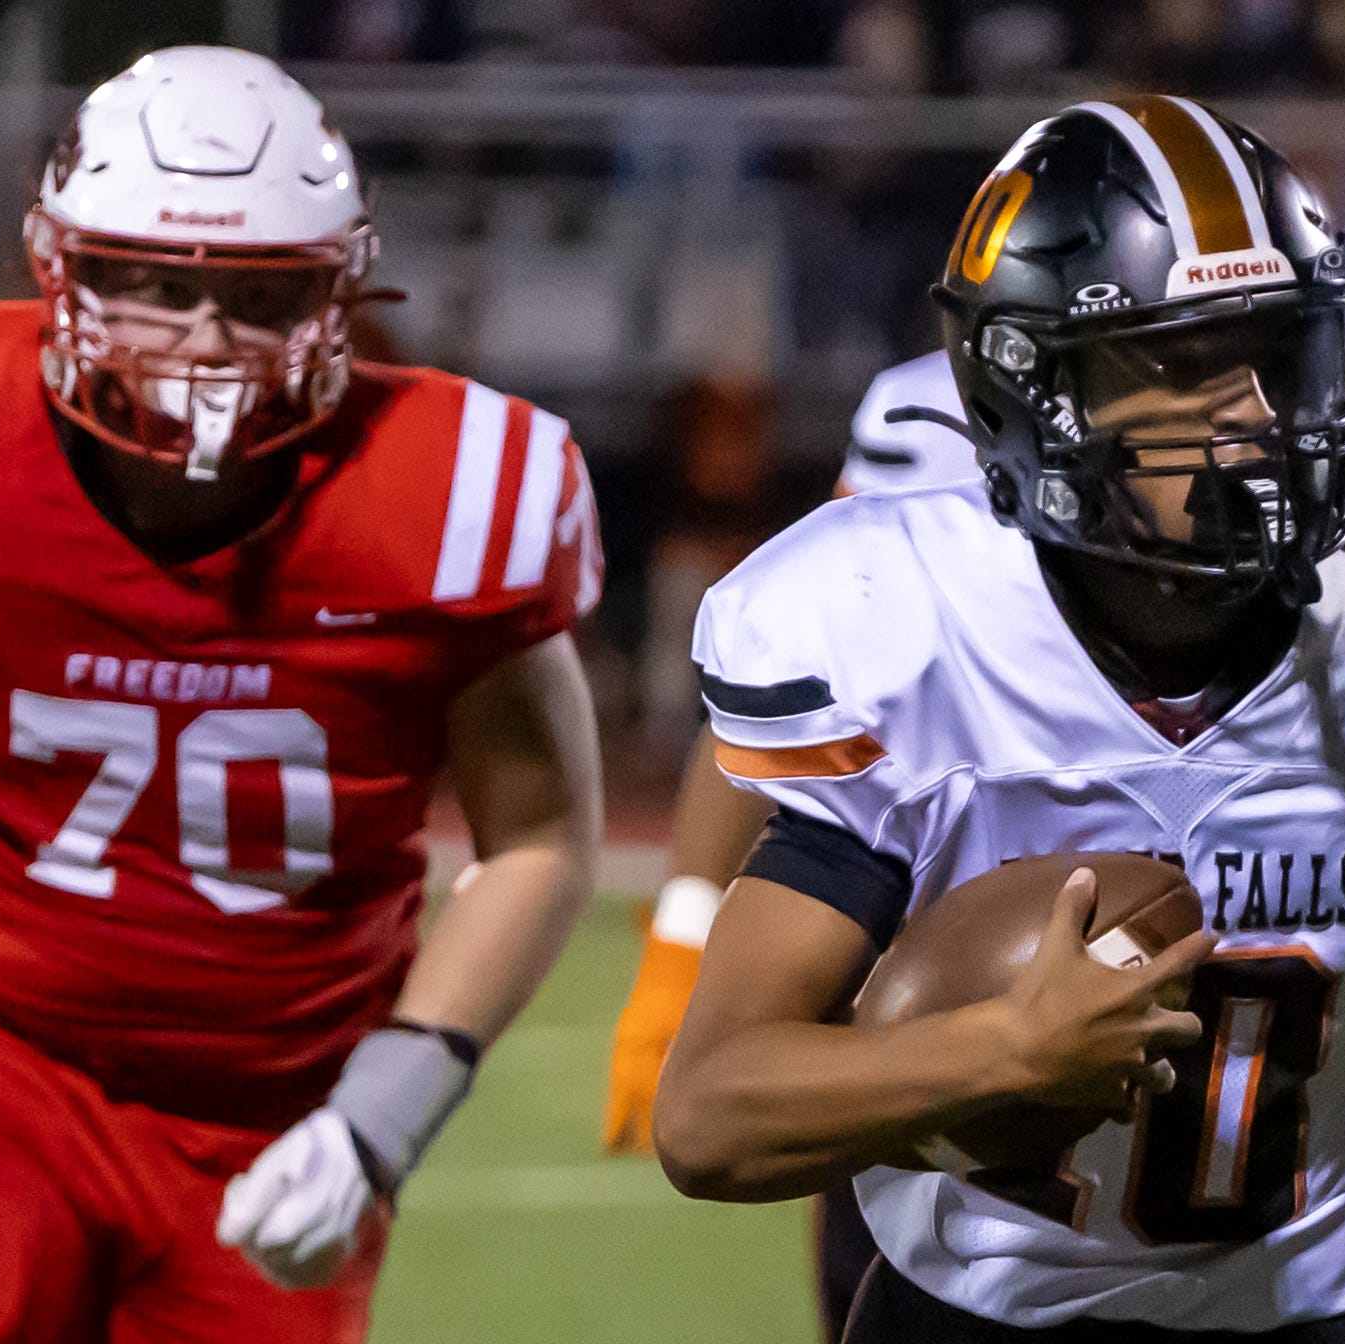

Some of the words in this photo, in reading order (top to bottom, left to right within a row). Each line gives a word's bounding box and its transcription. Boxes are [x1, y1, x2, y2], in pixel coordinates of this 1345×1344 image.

[1187, 259, 1281, 284] Riddell
[64, 653, 271, 701] FREEDOM
[8, 687, 334, 916] 70
[966, 944, 1340, 1246] 0
